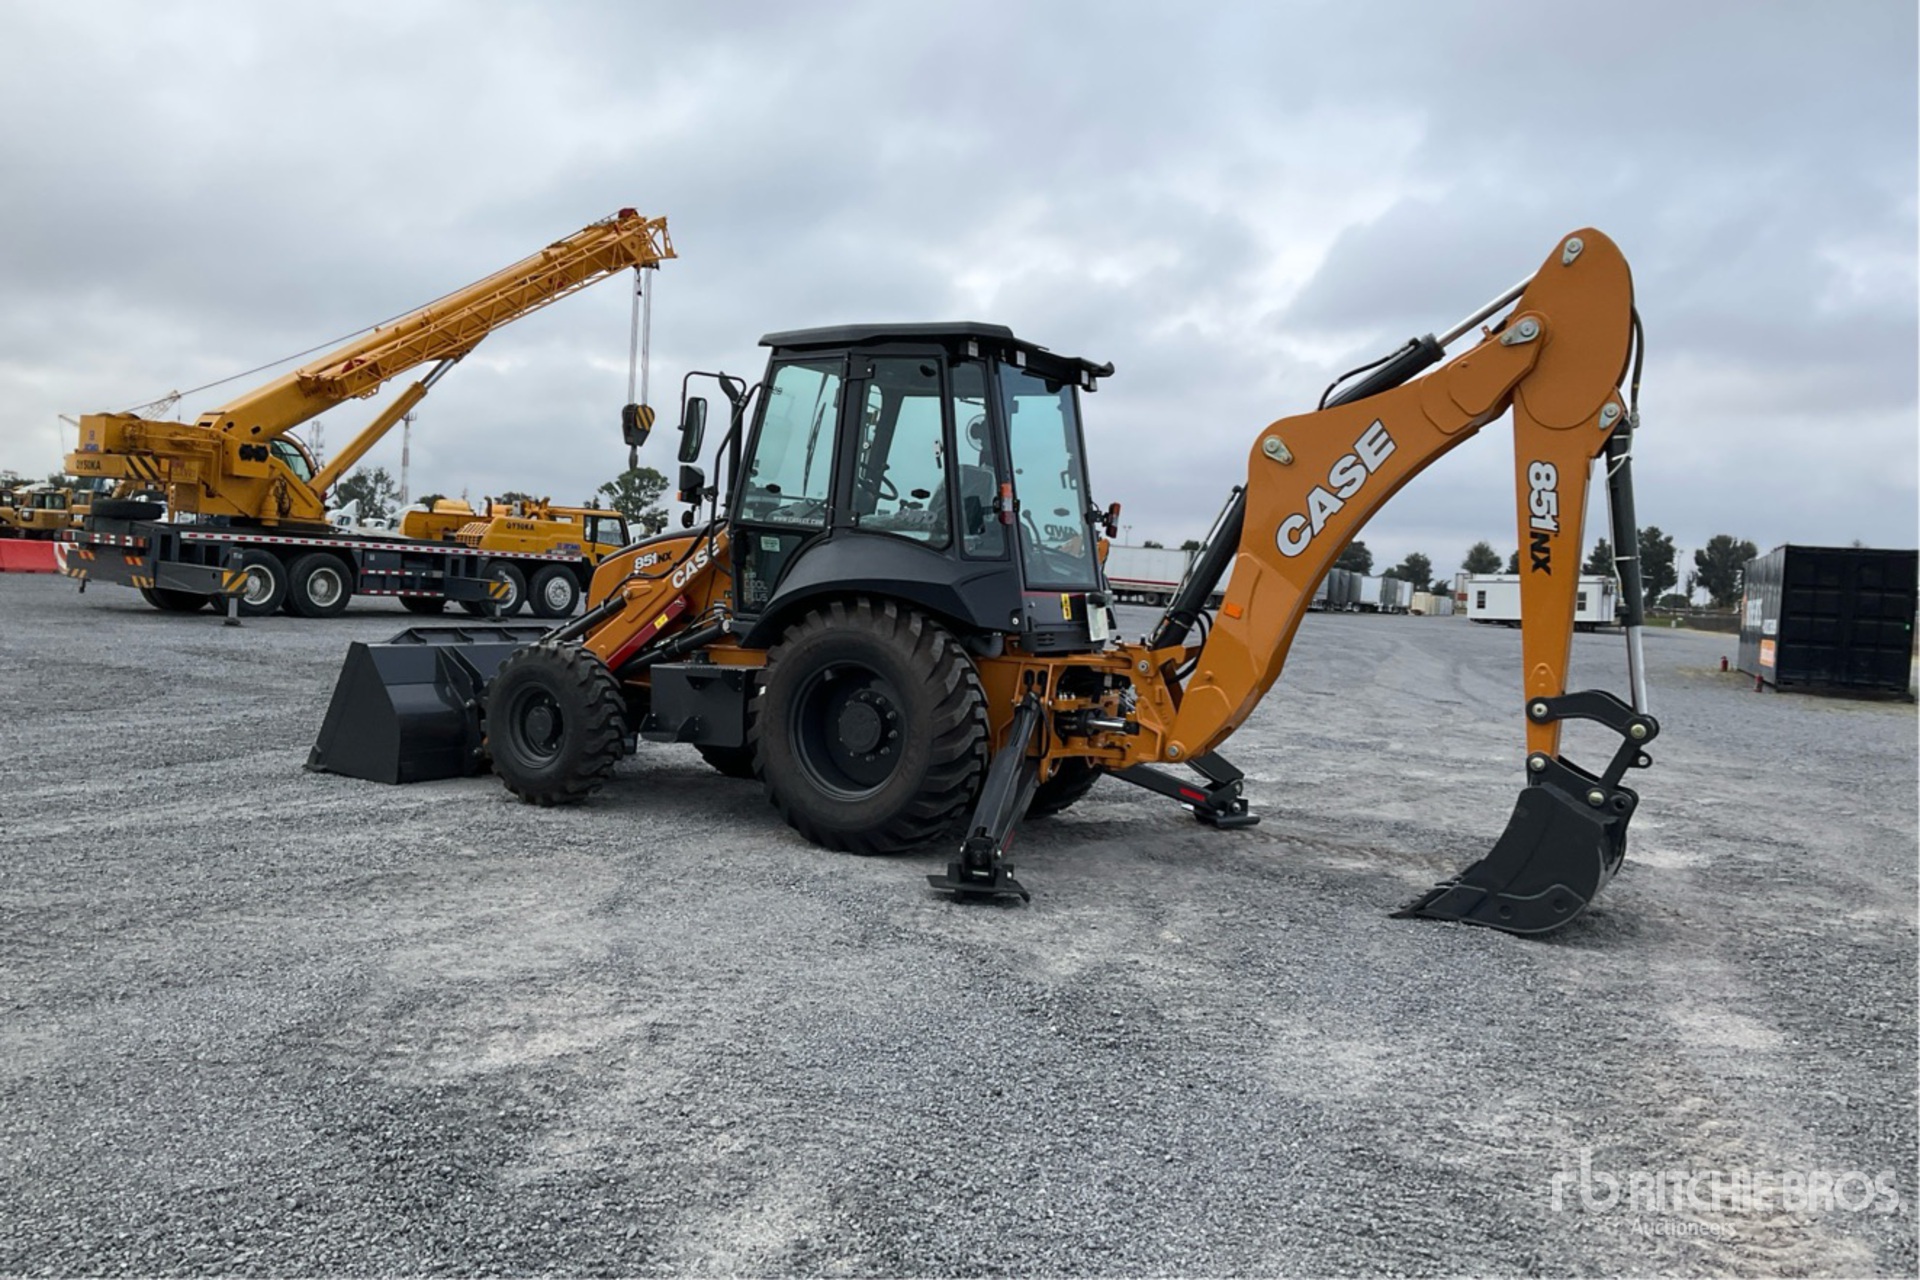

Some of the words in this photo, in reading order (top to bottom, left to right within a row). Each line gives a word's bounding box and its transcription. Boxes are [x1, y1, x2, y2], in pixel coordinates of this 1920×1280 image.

[1276, 418, 1398, 557] CASE
[1528, 460, 1559, 576] 851NX
[672, 537, 720, 588] CASE
